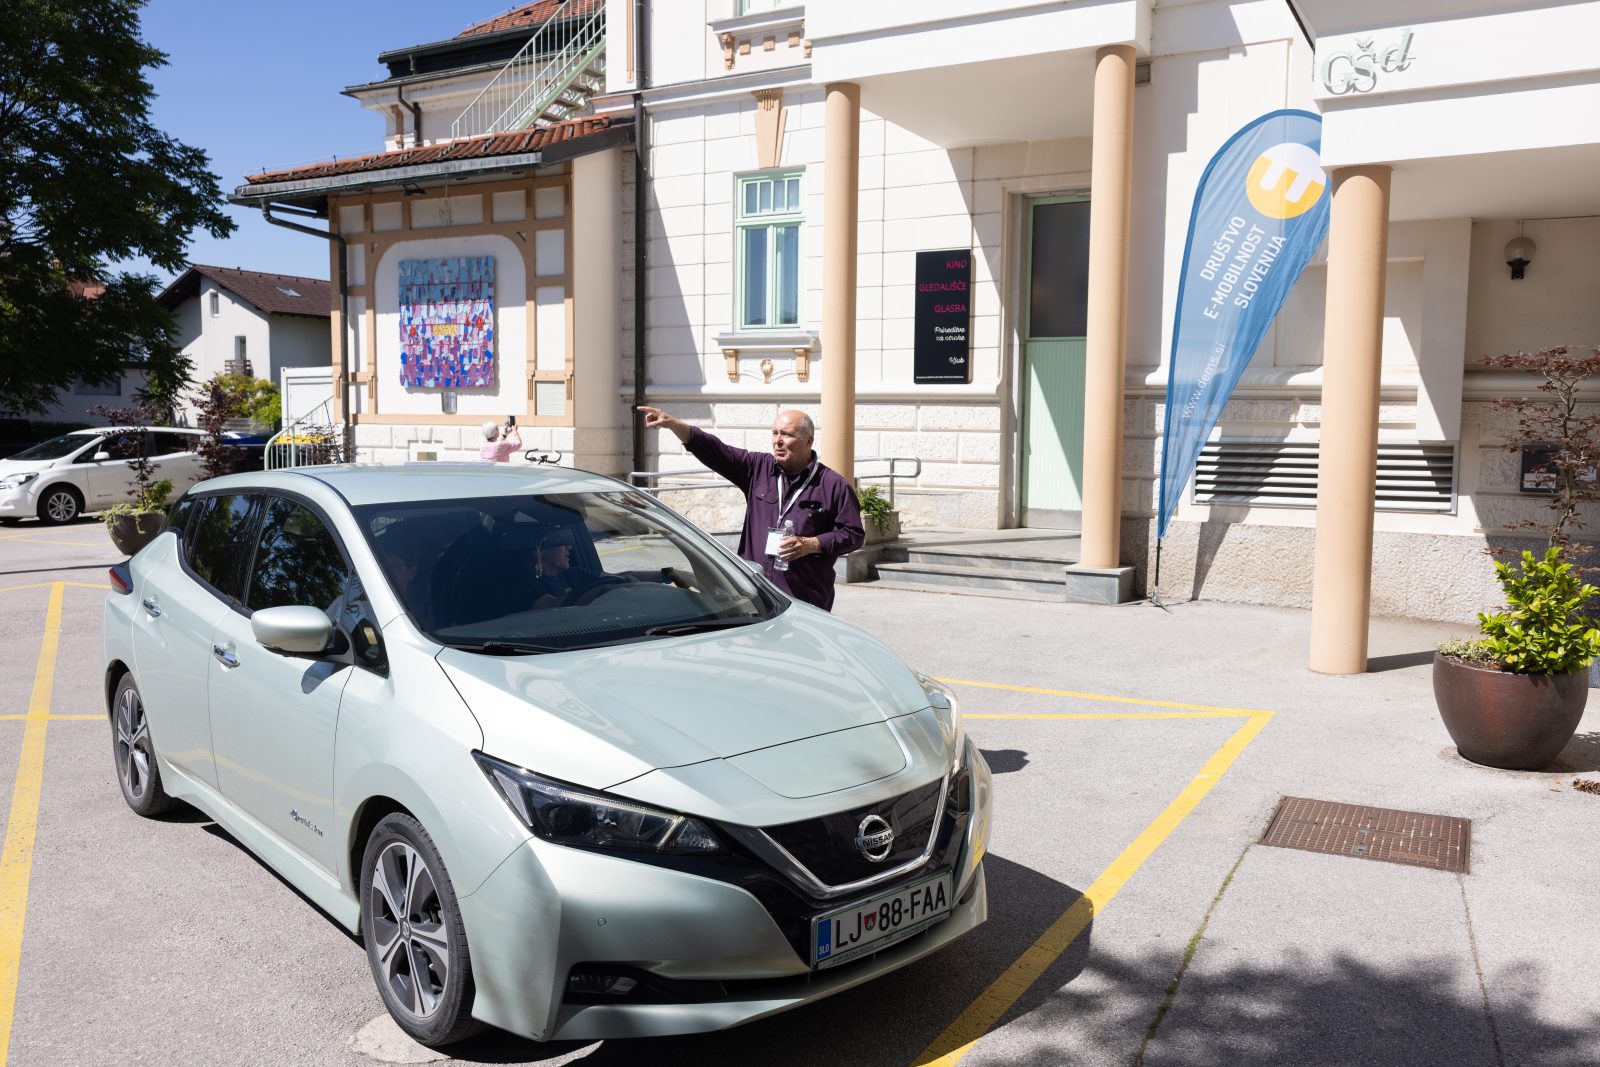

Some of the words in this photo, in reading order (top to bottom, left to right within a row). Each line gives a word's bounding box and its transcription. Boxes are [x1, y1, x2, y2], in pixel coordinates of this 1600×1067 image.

[945, 259, 968, 269] KINO
[1200, 216, 1246, 281] DRUŠTVO
[919, 280, 967, 292] GLEDALIŠČE
[1203, 224, 1265, 320] E-MOBILNOST
[1234, 236, 1287, 309] SLOVENIJA
[934, 304, 967, 313] GLASBA
[1182, 342, 1226, 418] www.dems.si
[863, 832, 893, 847] NISSAN
[836, 912, 862, 948] LJ
[878, 881, 947, 932] 88-FAA
[818, 944, 830, 955] SLO
